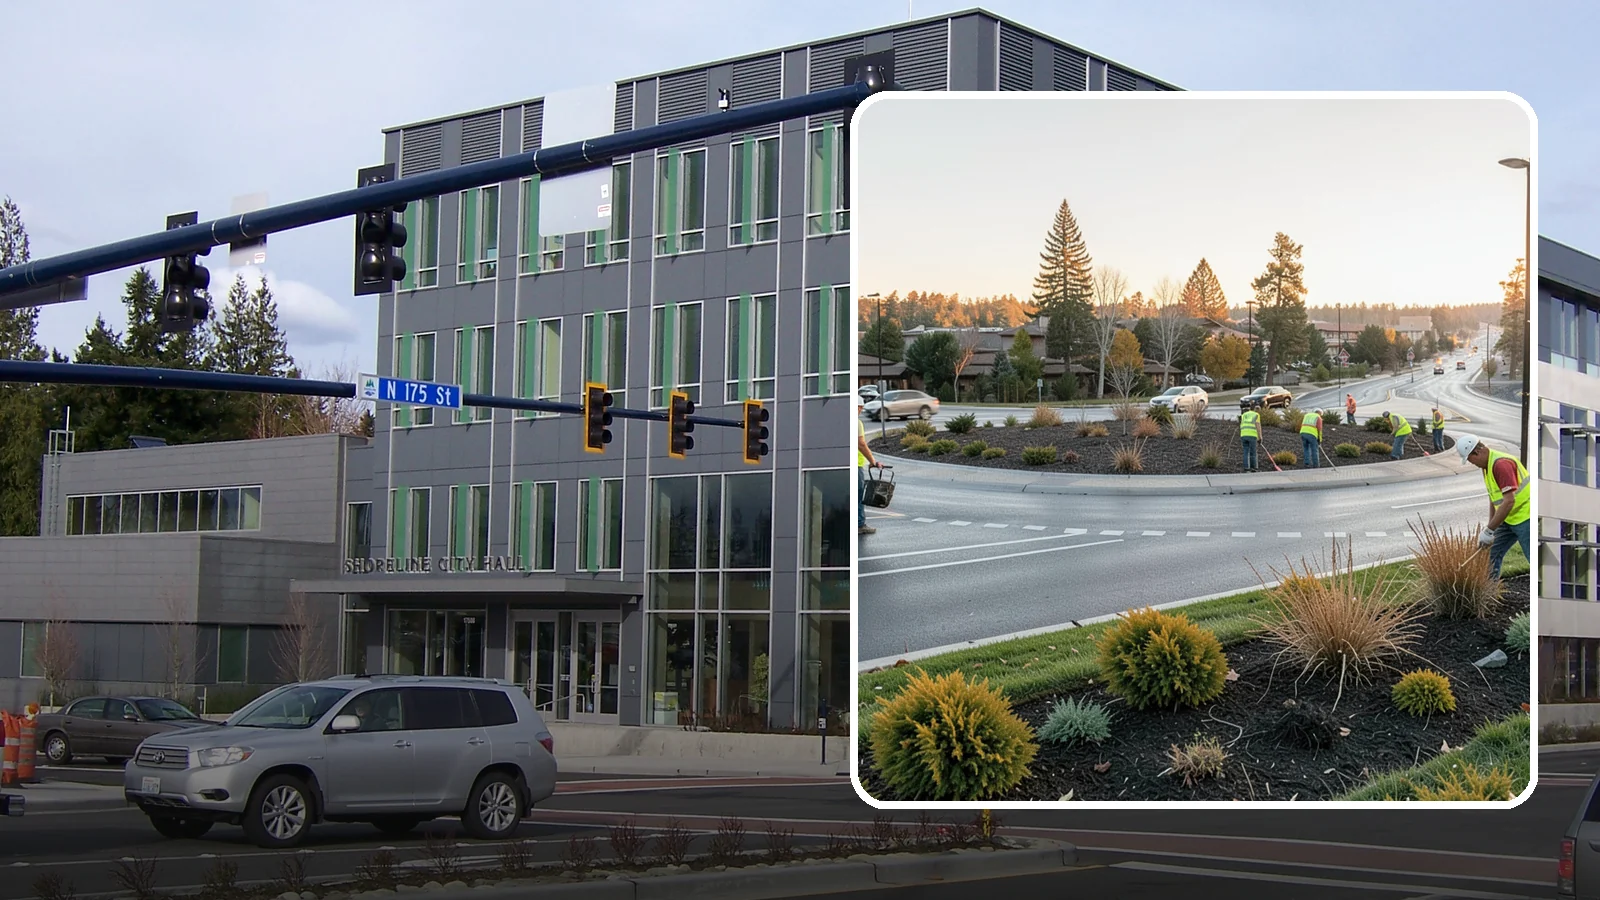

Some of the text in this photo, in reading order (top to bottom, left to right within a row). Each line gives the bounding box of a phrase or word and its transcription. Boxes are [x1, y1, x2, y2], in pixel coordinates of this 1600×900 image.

[387, 381, 451, 406] N 175 St
[345, 555, 525, 574] SHORELINE CITY HALL
